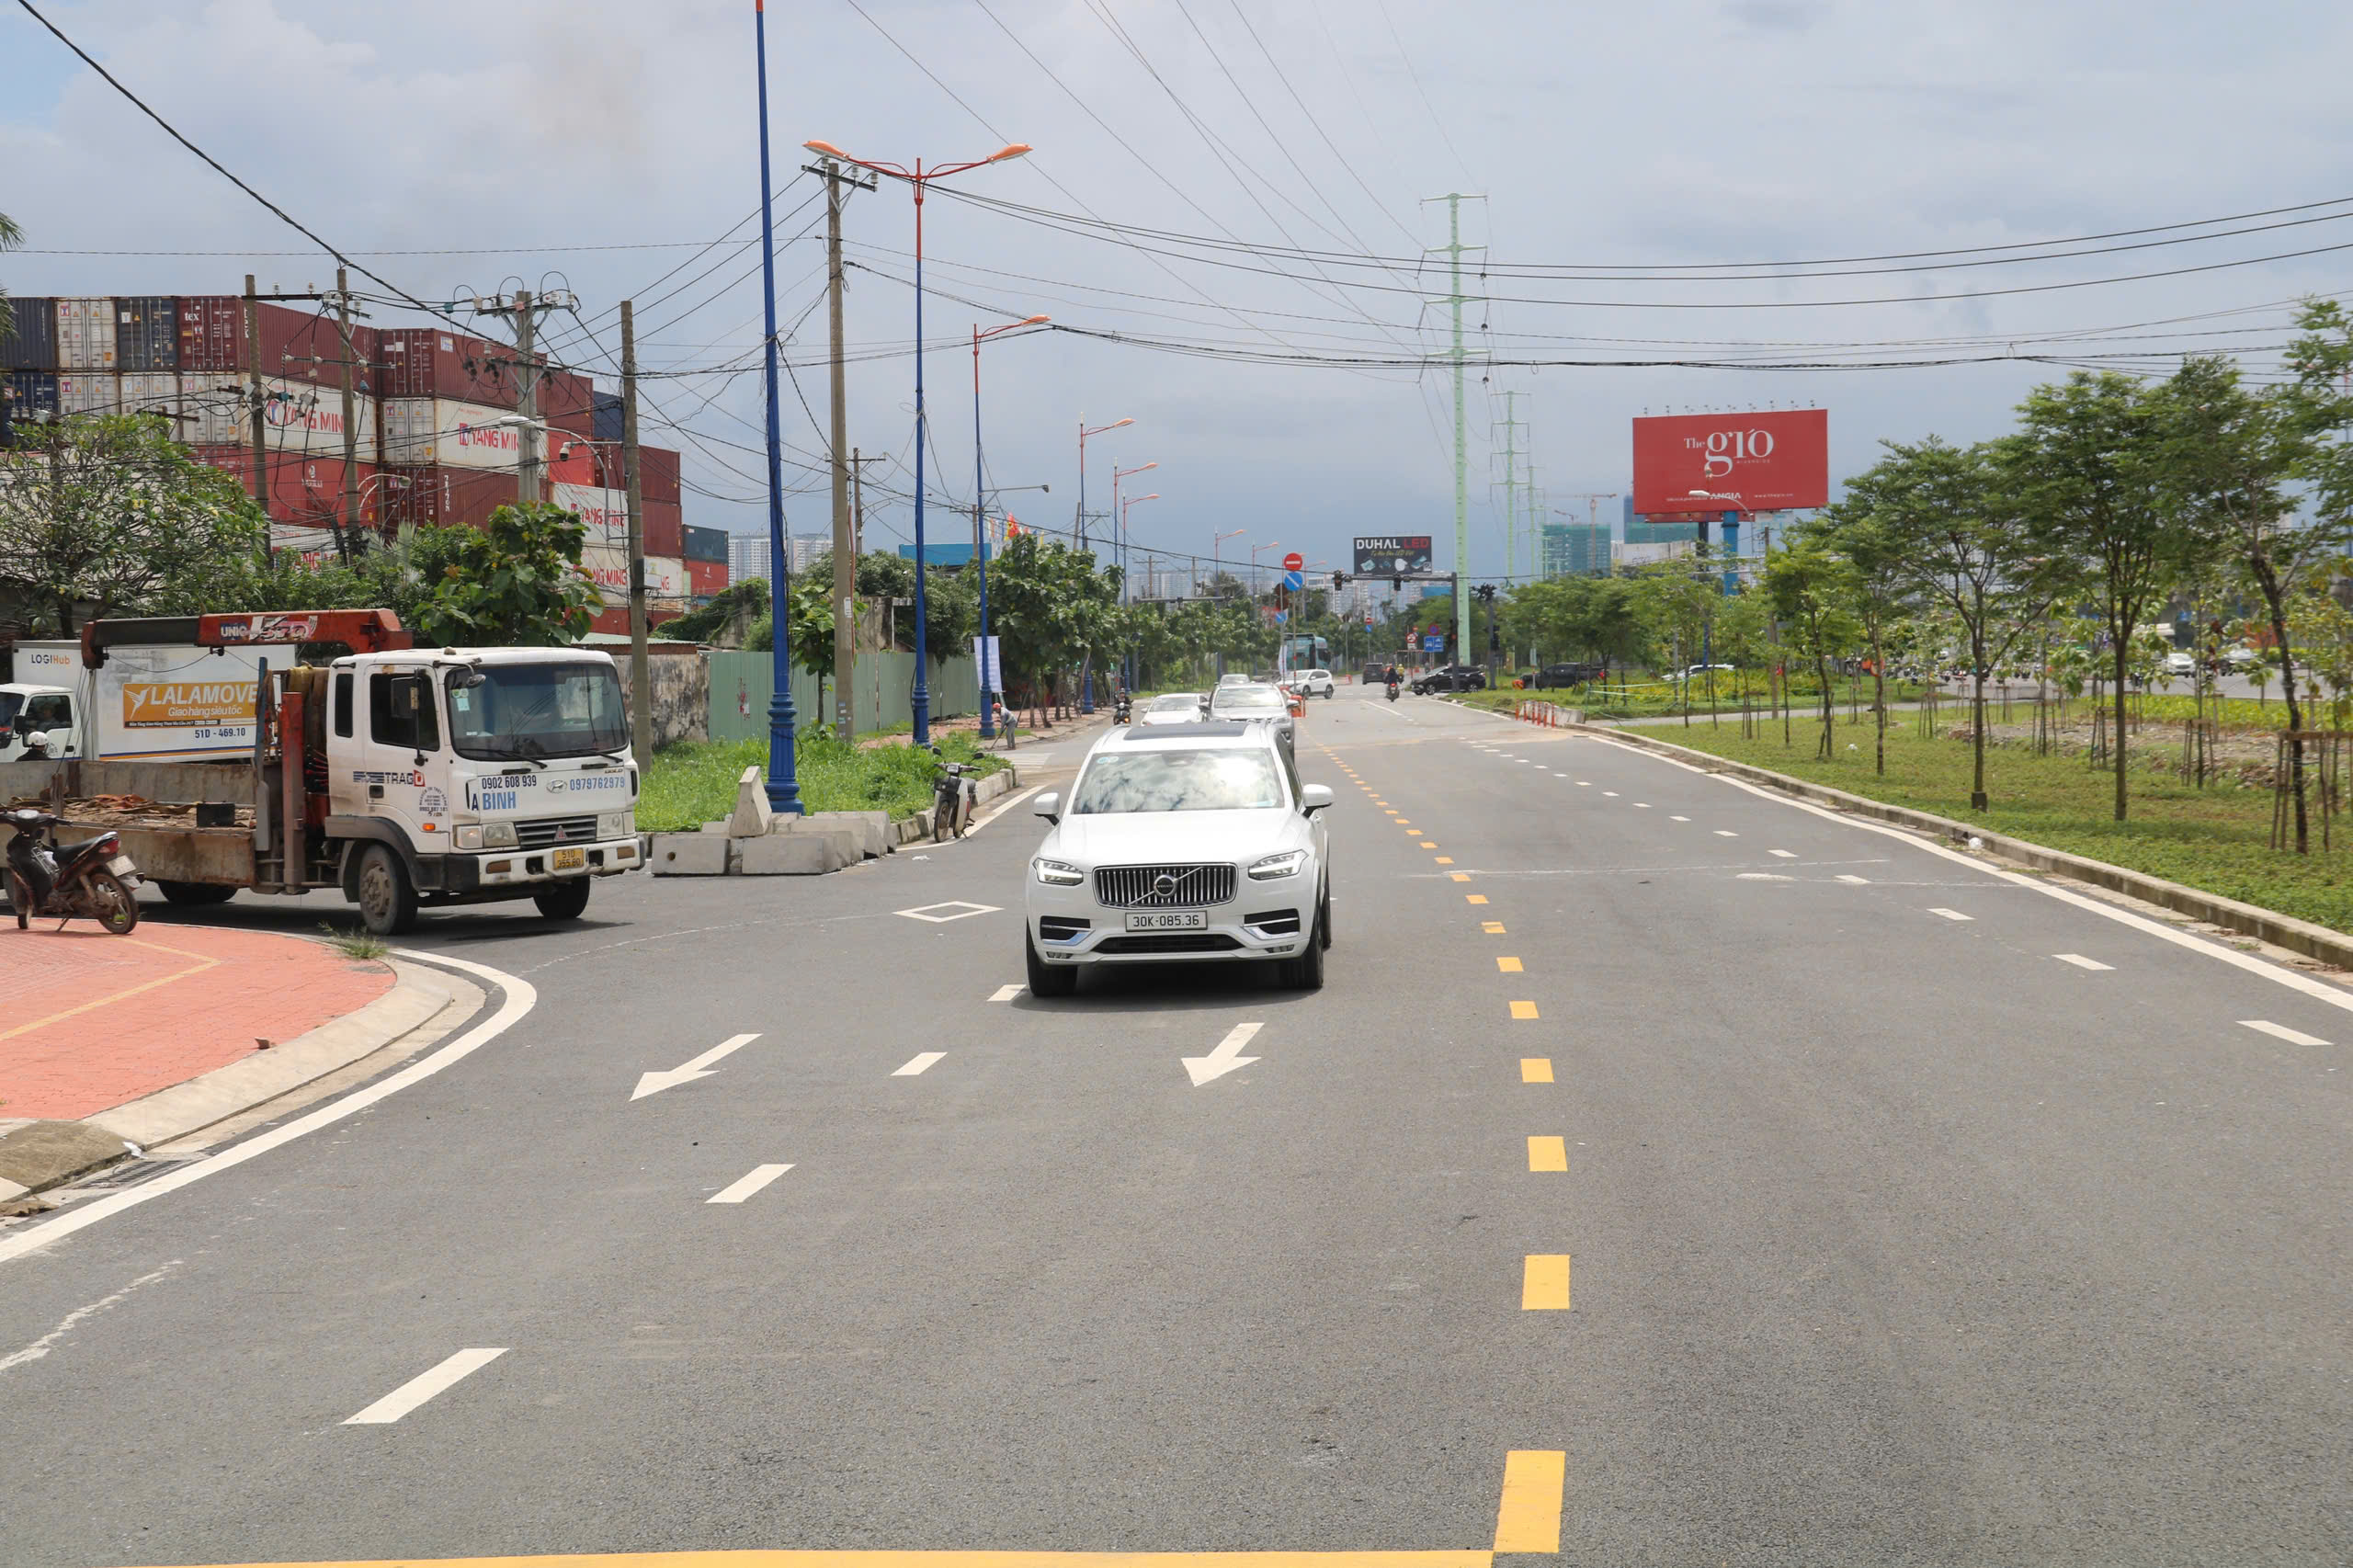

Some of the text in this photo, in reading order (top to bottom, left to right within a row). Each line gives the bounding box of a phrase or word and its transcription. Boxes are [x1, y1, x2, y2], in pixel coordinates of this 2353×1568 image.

[319, 410, 344, 434] MIN
[471, 426, 519, 451] YANG MIN
[1684, 437, 1706, 449] The
[1356, 537, 1428, 550] DUHAL LED
[30, 653, 71, 665] LOGIHub
[168, 707, 188, 717] Giao
[194, 729, 210, 739] 51D
[218, 727, 246, 738] 469.10
[482, 775, 537, 790] 0902 608 939
[570, 777, 626, 791] 0979762979
[472, 793, 479, 811] A
[1133, 915, 1199, 927] 30K-085.36
